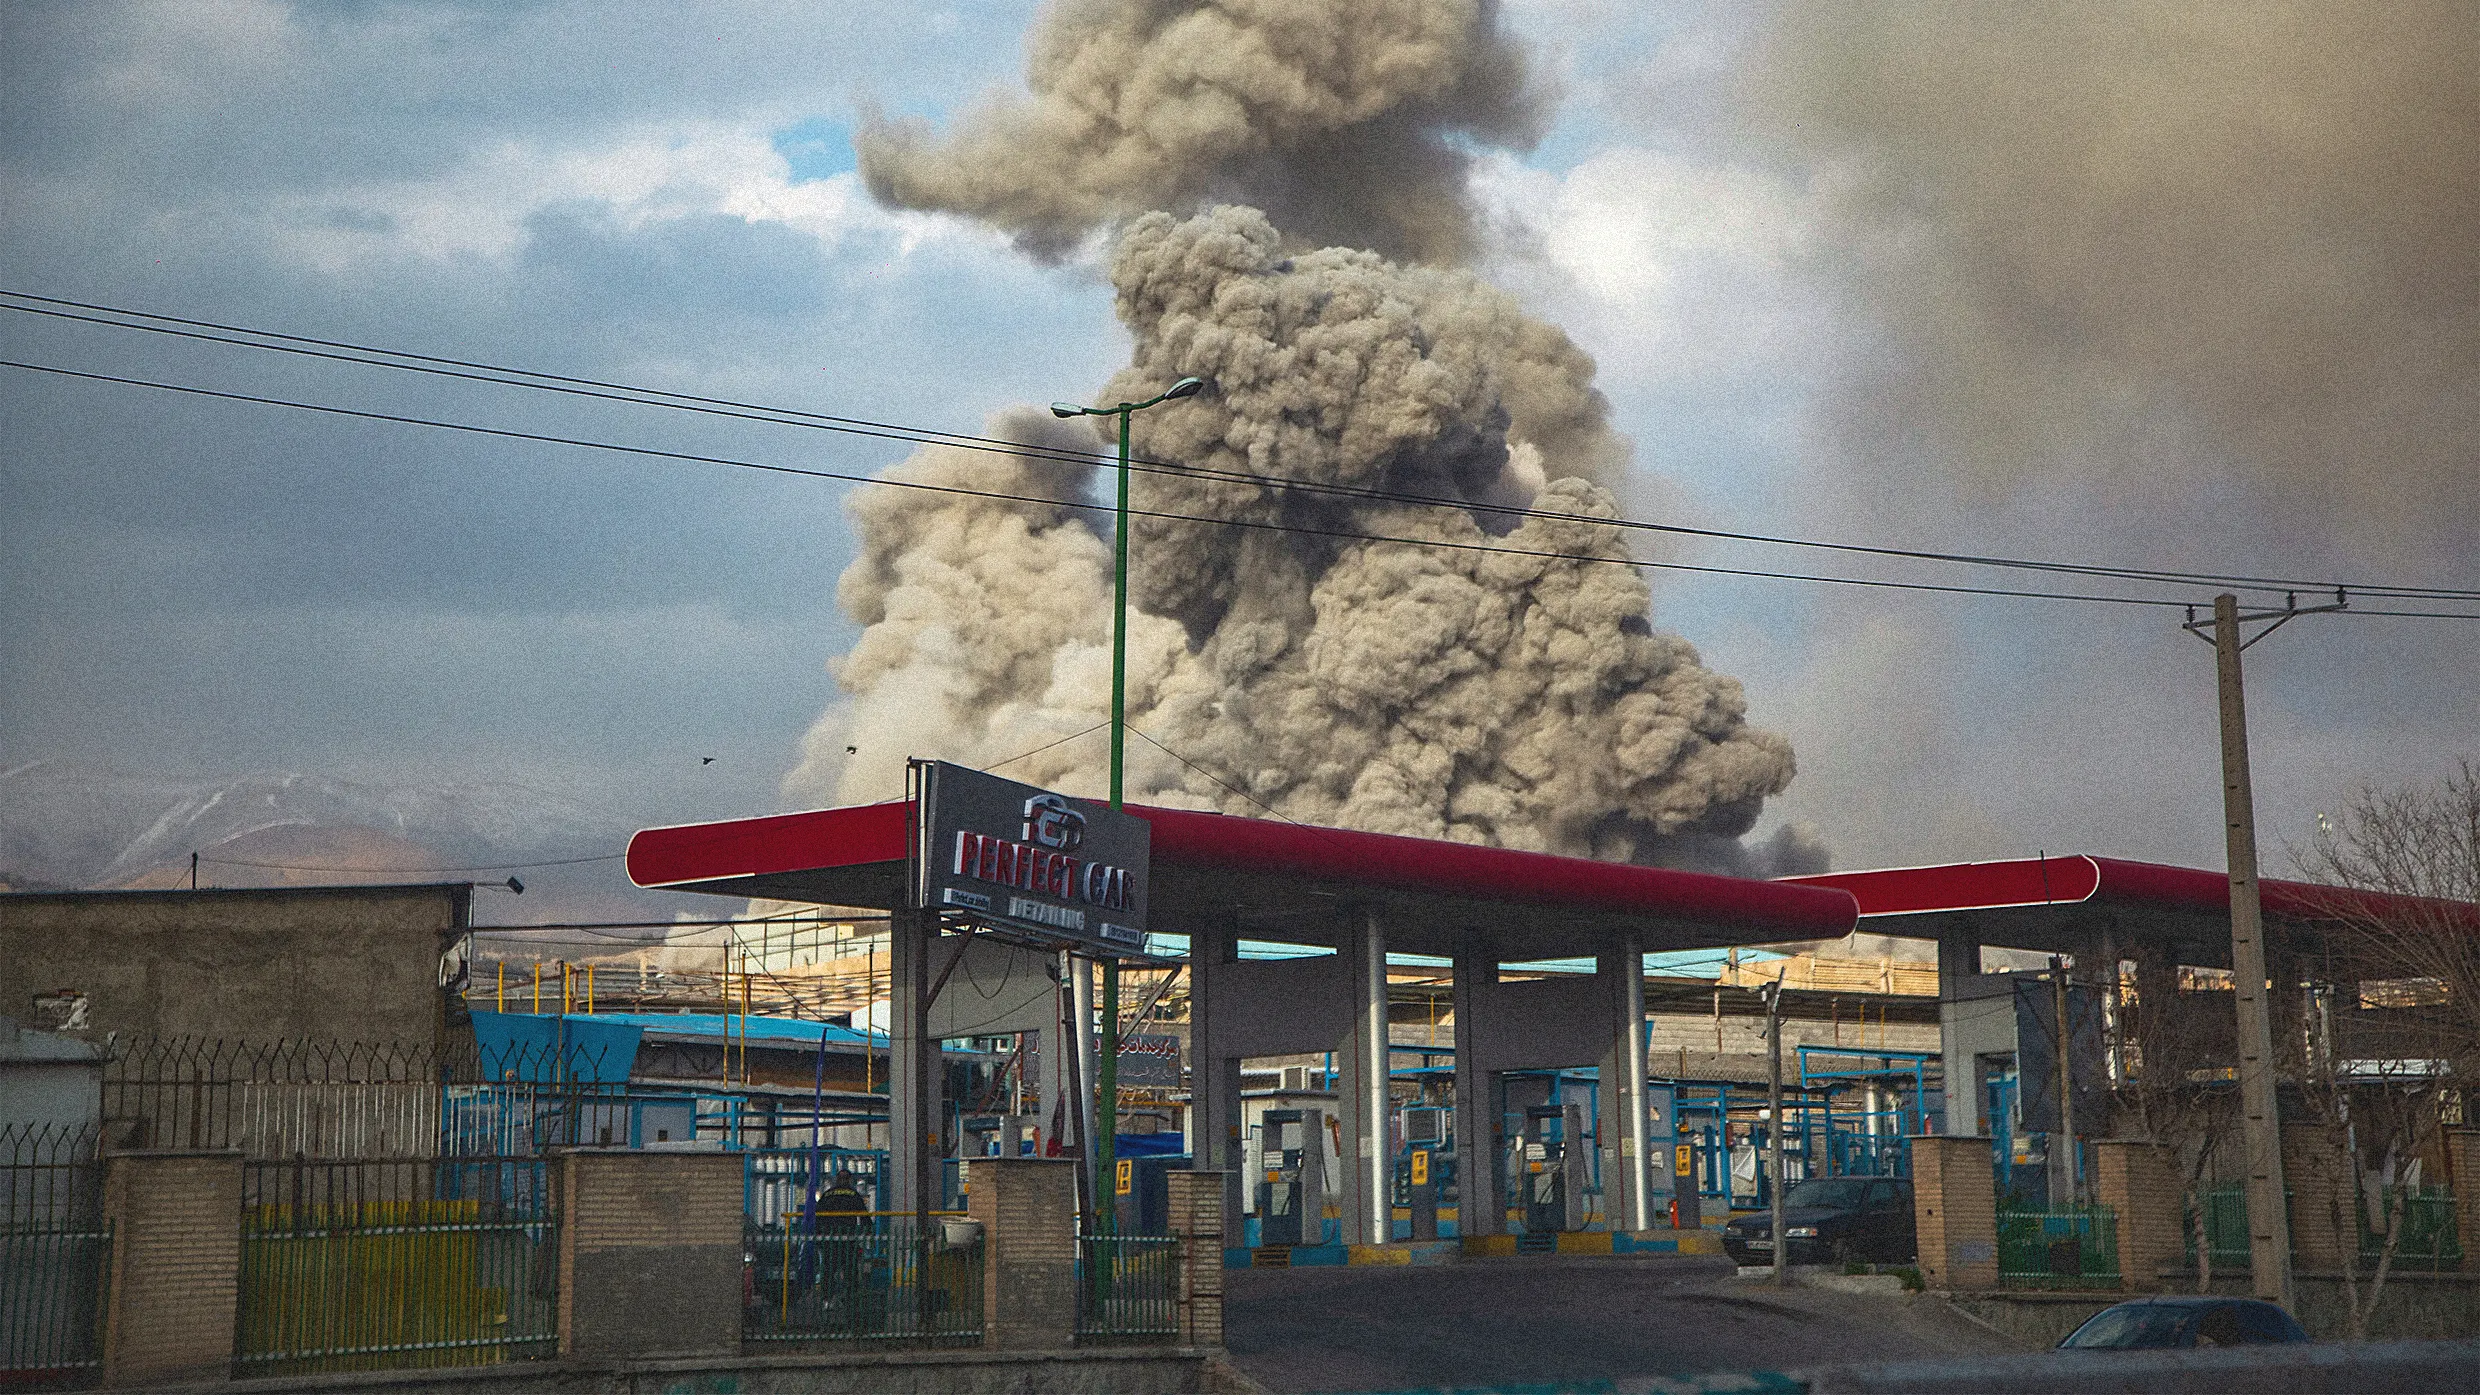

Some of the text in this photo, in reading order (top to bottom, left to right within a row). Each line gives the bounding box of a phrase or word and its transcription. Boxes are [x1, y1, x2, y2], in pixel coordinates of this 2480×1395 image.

[954, 831, 1137, 912] PERFECT CAR
[1008, 896, 1085, 931] DETAILING
